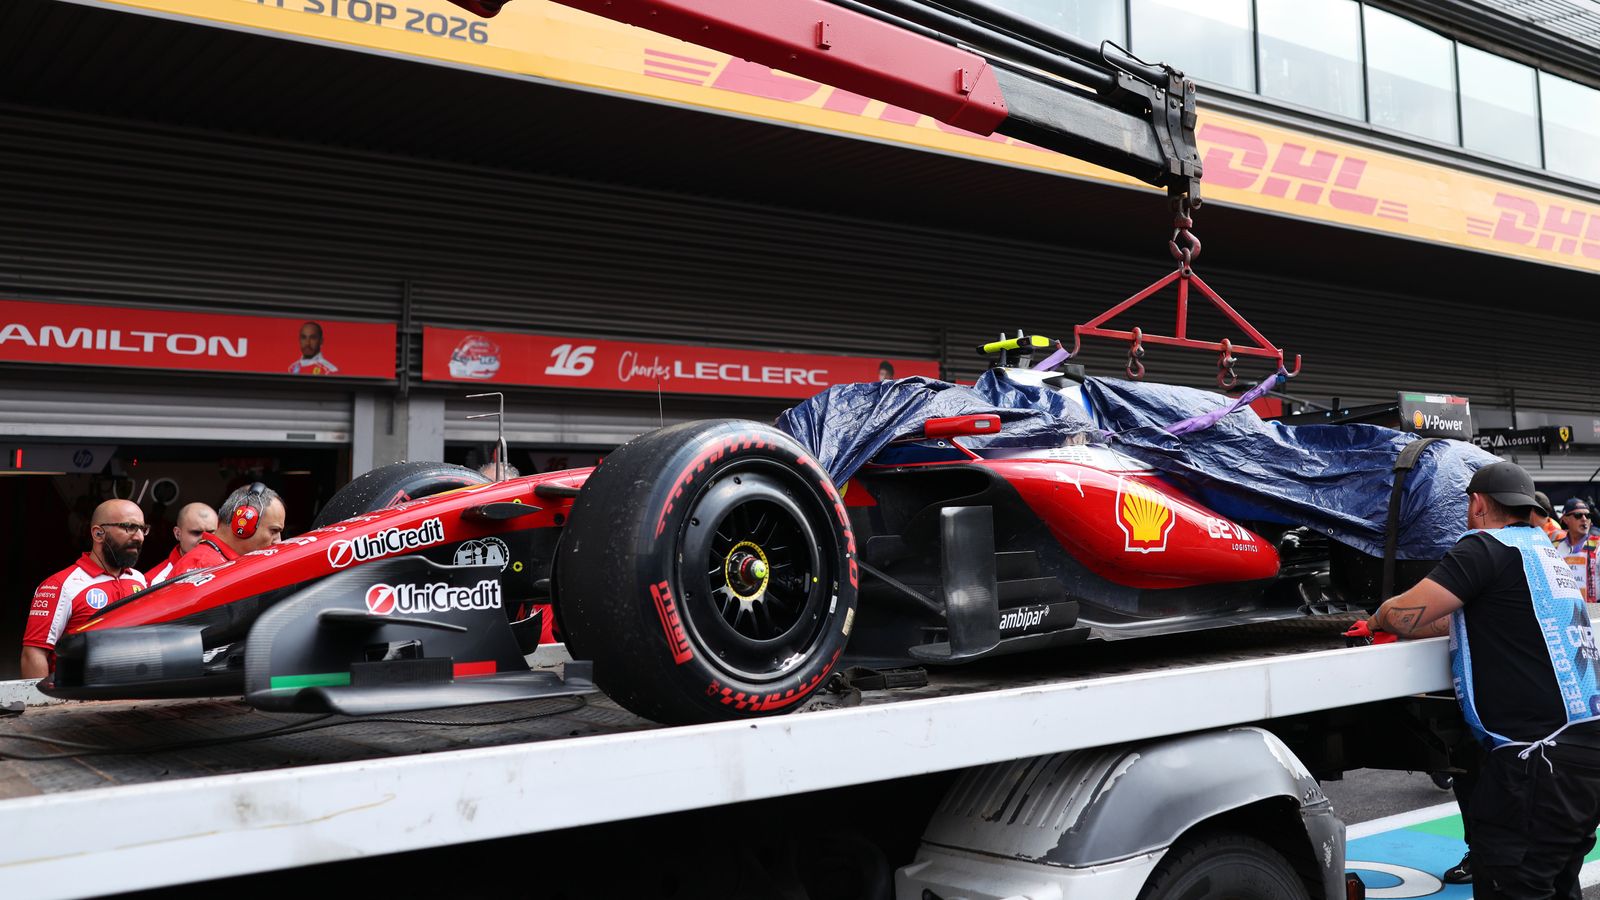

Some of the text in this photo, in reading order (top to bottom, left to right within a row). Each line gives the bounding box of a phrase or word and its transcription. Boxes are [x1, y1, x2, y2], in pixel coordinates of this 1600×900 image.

[404, 7, 489, 45] 2026
[1198, 122, 1379, 216] DHL
[0, 323, 248, 358] AMILTON
[544, 343, 829, 387] 16 Charles LECLERC
[1423, 413, 1464, 432] V-Power
[353, 517, 444, 561] UniCredit
[1231, 542, 1259, 553] LOGISTICS
[91, 590, 105, 609] hp
[397, 580, 501, 612] UniCredit
[649, 579, 694, 666] PIRELLI
[1541, 617, 1587, 715] BELGIUM
